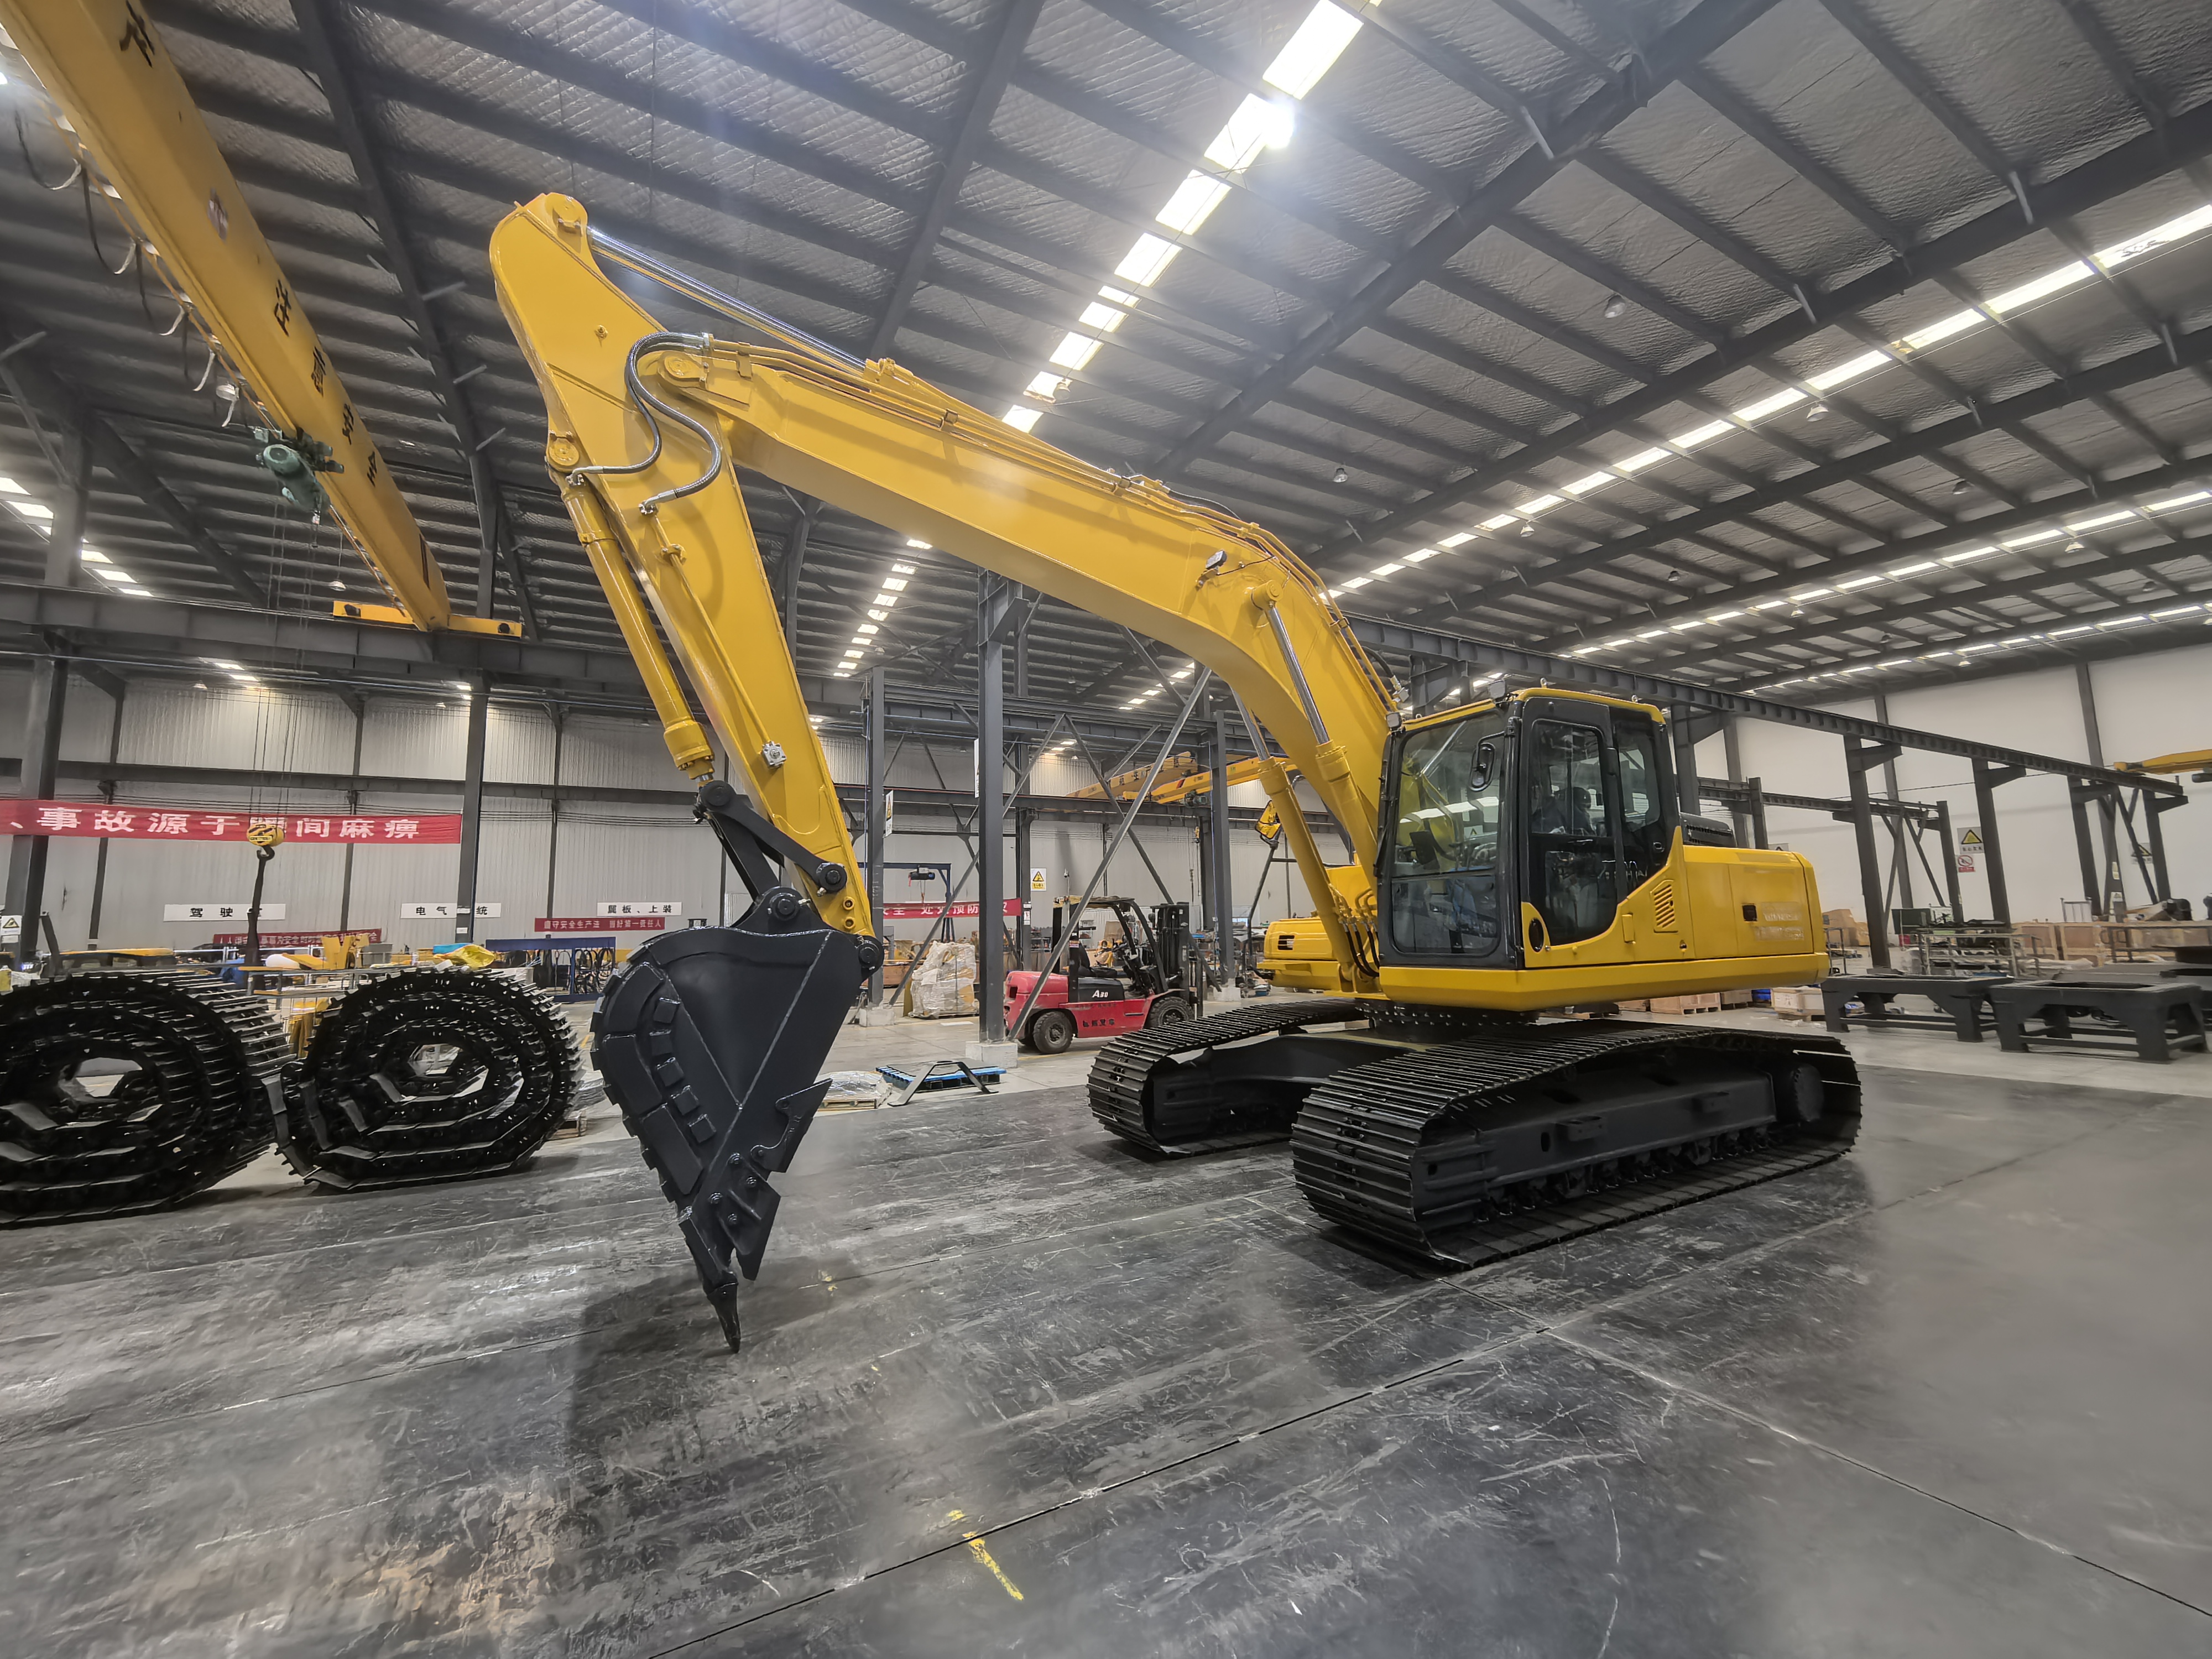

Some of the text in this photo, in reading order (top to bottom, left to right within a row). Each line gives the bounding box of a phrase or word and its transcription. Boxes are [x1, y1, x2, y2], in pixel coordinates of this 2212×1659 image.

[416, 906, 488, 915] 电气统
[1092, 989, 1108, 998] A30
